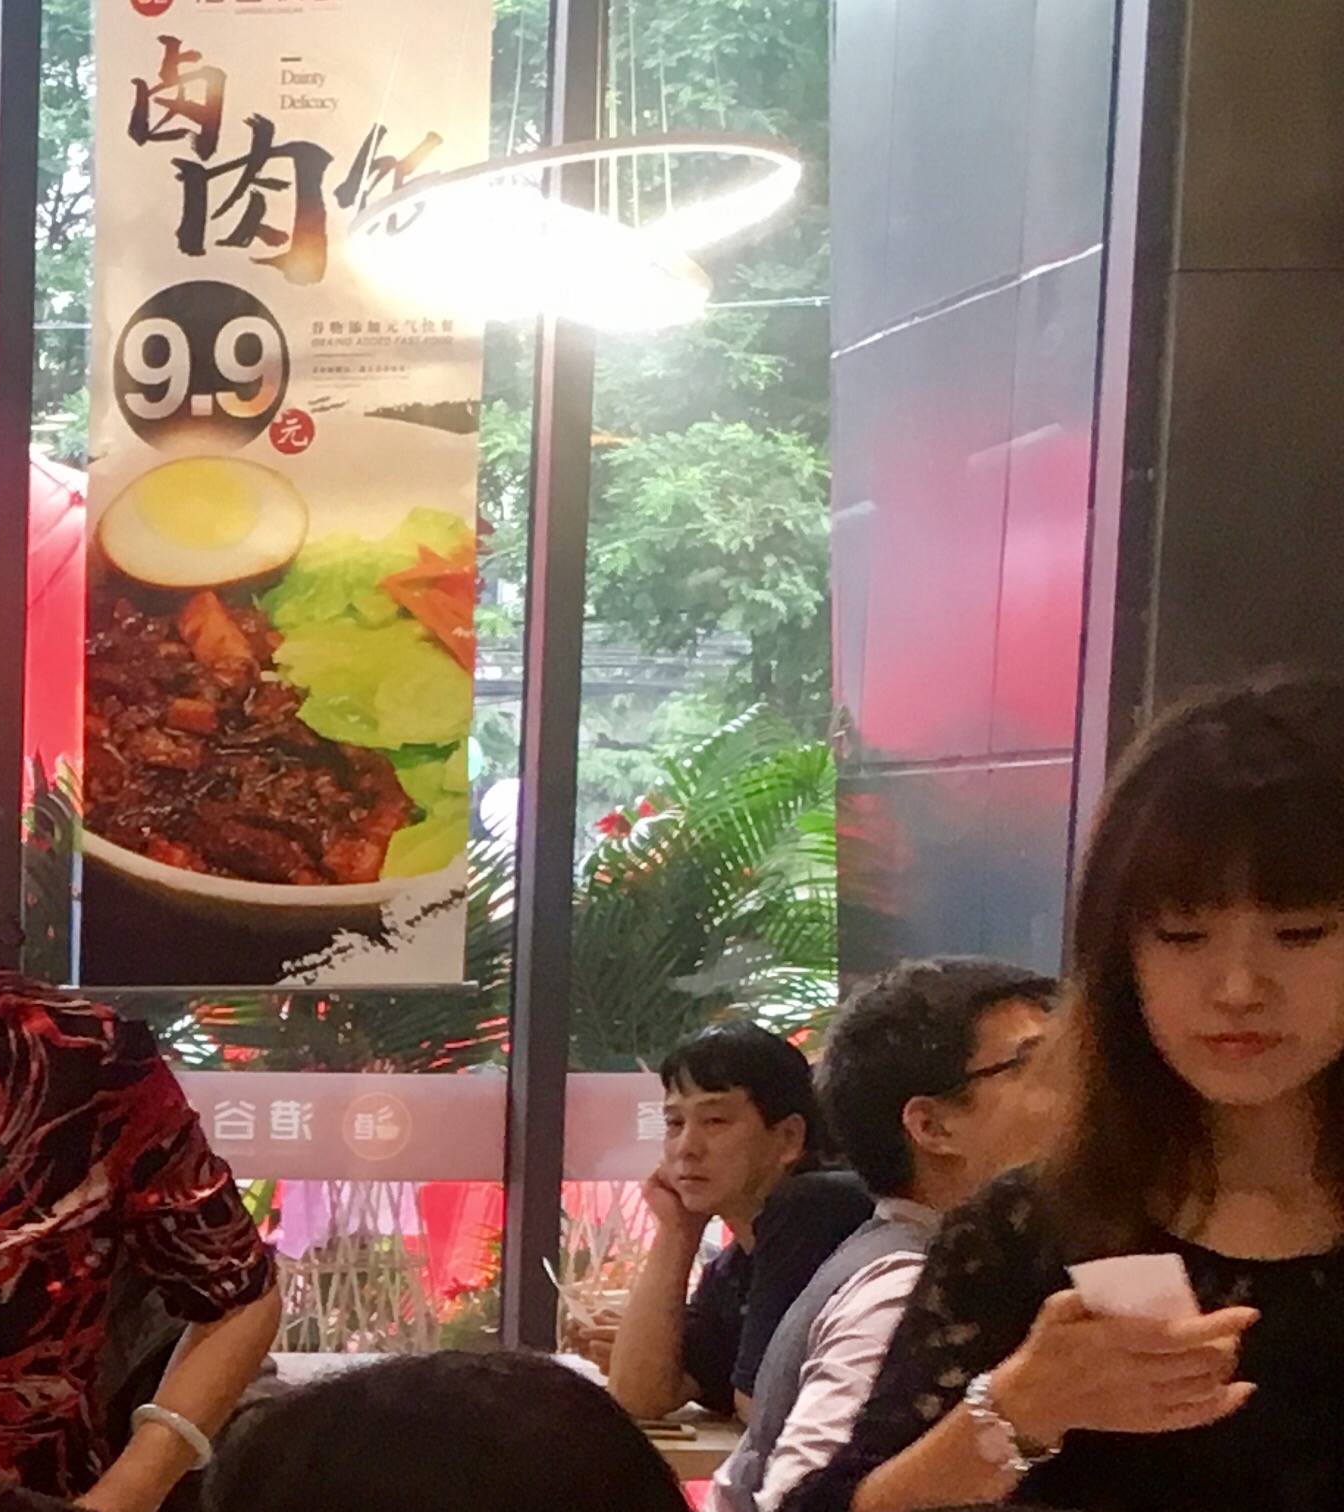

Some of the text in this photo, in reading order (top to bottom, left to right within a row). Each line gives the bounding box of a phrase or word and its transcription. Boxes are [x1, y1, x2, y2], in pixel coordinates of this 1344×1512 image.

[280, 69, 327, 88] Dainty
[280, 94, 339, 111] Delicacy
[123, 317, 310, 447] 9.9 元
